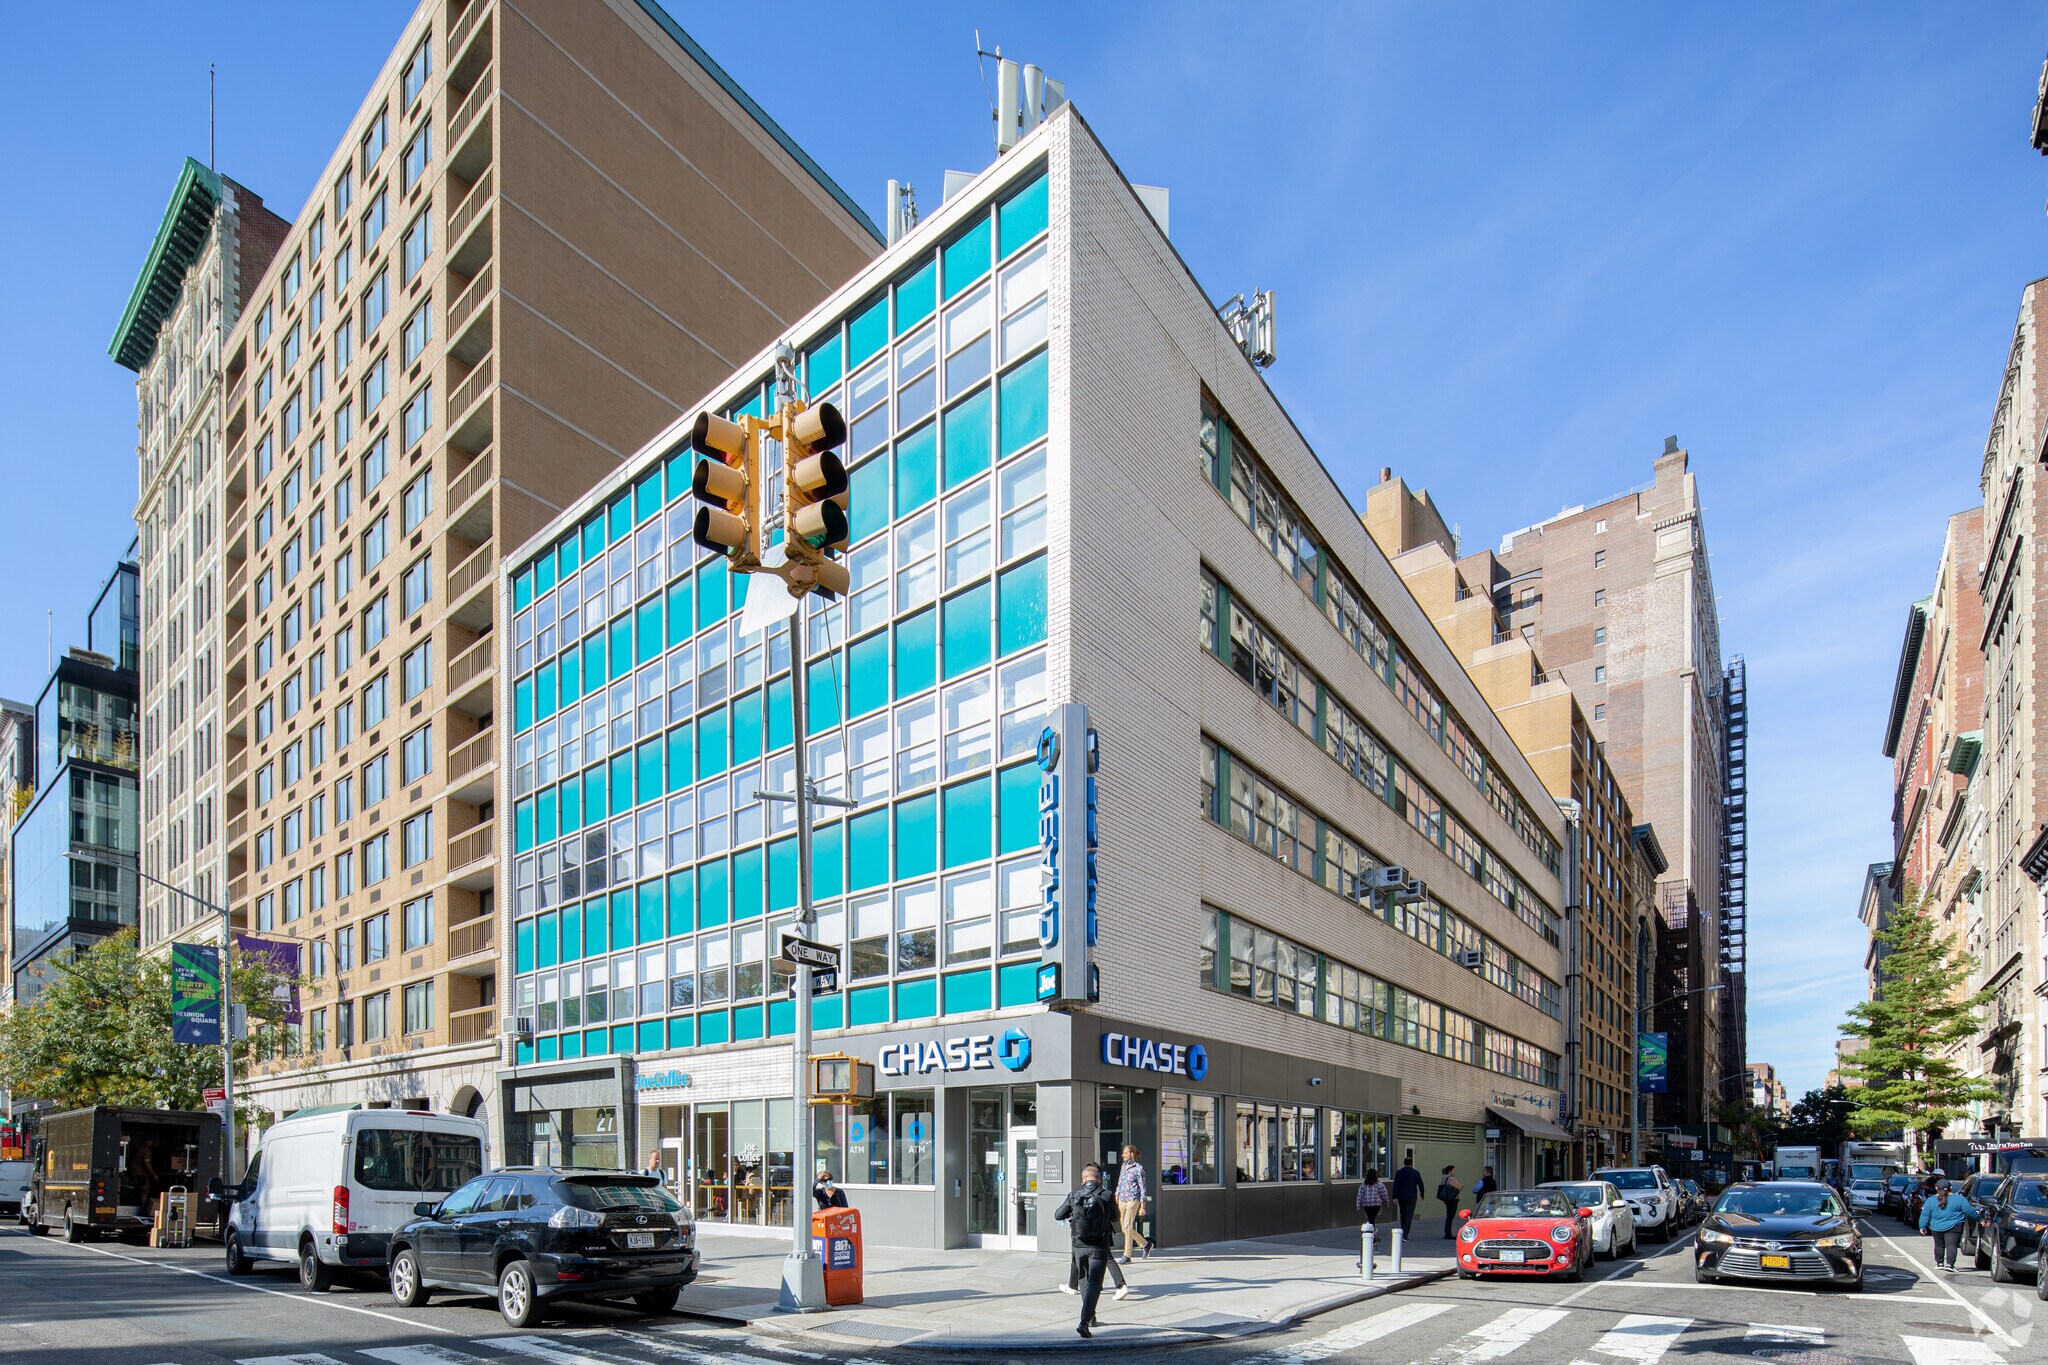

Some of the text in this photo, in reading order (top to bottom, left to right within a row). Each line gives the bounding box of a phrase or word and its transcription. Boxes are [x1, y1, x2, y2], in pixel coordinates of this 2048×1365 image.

[1038, 774, 1058, 947] CHASE
[791, 944, 834, 964] ONE WAY
[175, 980, 211, 989] FRUITFUL
[815, 975, 831, 987] WAY
[182, 991, 216, 1000] STROLLS
[878, 1035, 994, 1076] CHASE
[1103, 1032, 1187, 1075] CHASE
[596, 1108, 616, 1132] 27
[743, 1142, 758, 1154] Joe
[849, 1146, 865, 1154] ATM
[908, 1145, 926, 1154] ATM
[737, 1153, 761, 1162] Coffee
